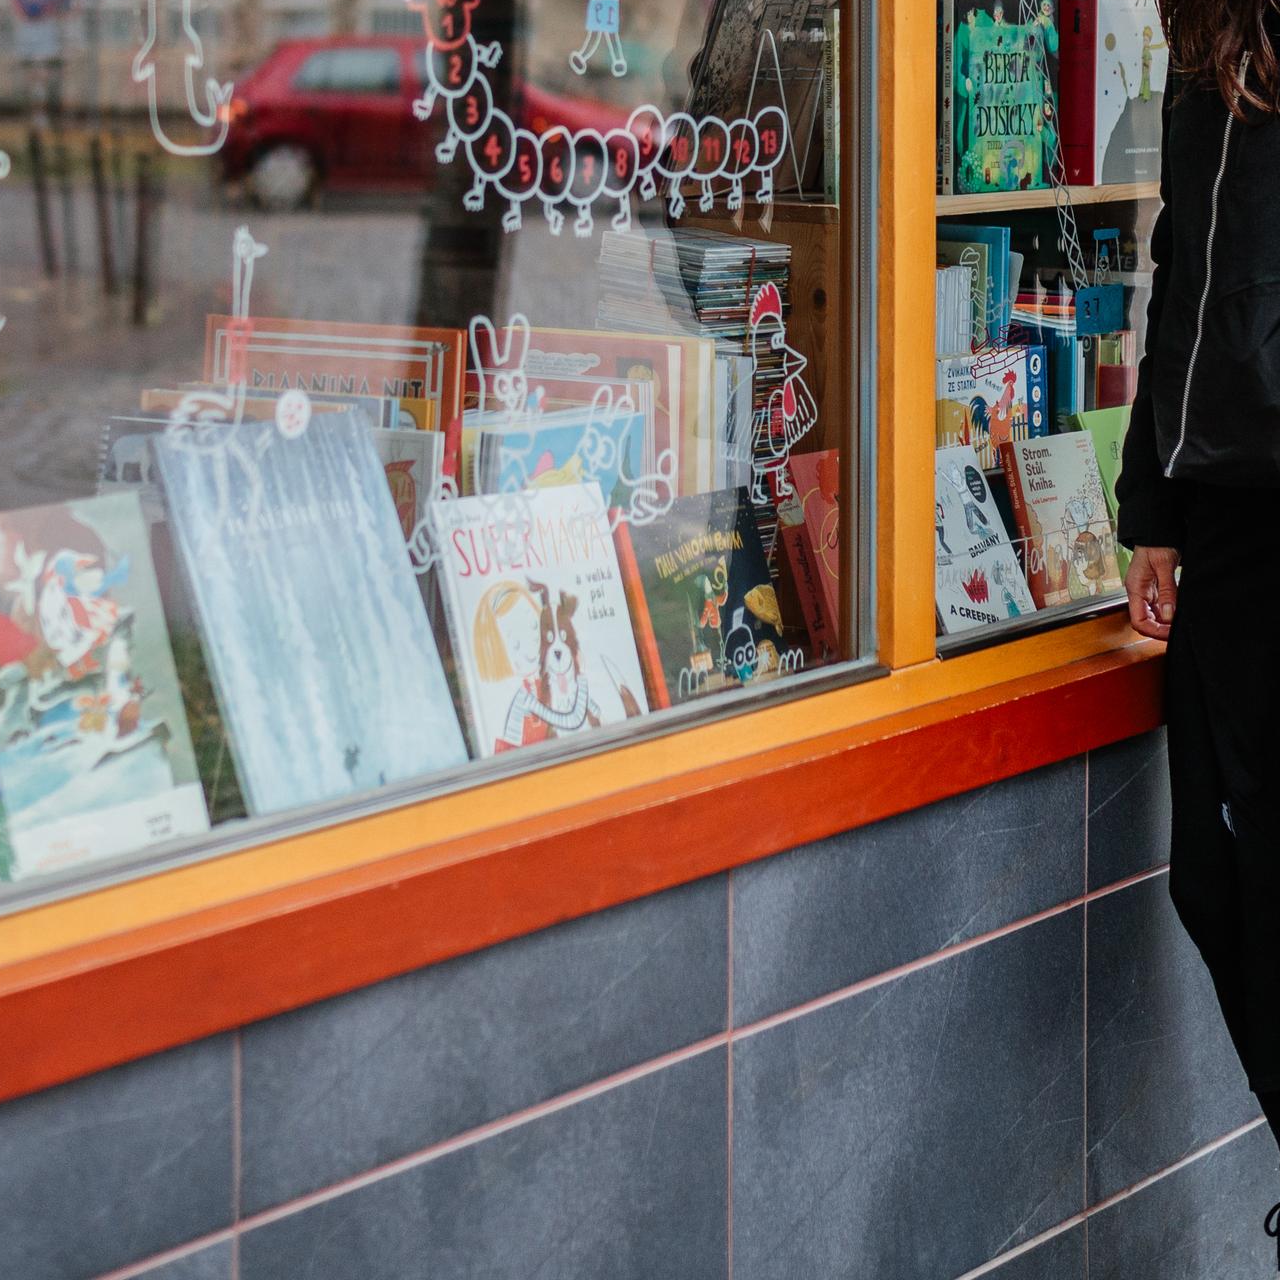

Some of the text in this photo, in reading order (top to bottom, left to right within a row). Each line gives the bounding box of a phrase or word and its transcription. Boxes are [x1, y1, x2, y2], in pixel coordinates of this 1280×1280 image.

[442, 13, 454, 38] 1
[449, 54, 462, 85] 2
[984, 52, 1030, 84] BERTA
[466, 96, 479, 126] 3
[484, 133, 502, 167] 4
[641, 127, 652, 156] 9
[670, 135, 689, 162] 10
[703, 136, 720, 162] 11
[733, 139, 750, 164] 12
[761, 129, 777, 155] 13
[519, 154, 531, 183] 5
[549, 157, 563, 183] 6
[615, 148, 628, 178] 8
[1022, 448, 1052, 461] Strom.
[1025, 461, 1047, 477] Stůl.
[1028, 478, 1056, 492] Kniha.
[587, 567, 613, 584] velká
[587, 606, 616, 621] láska
[950, 604, 957, 616] A
